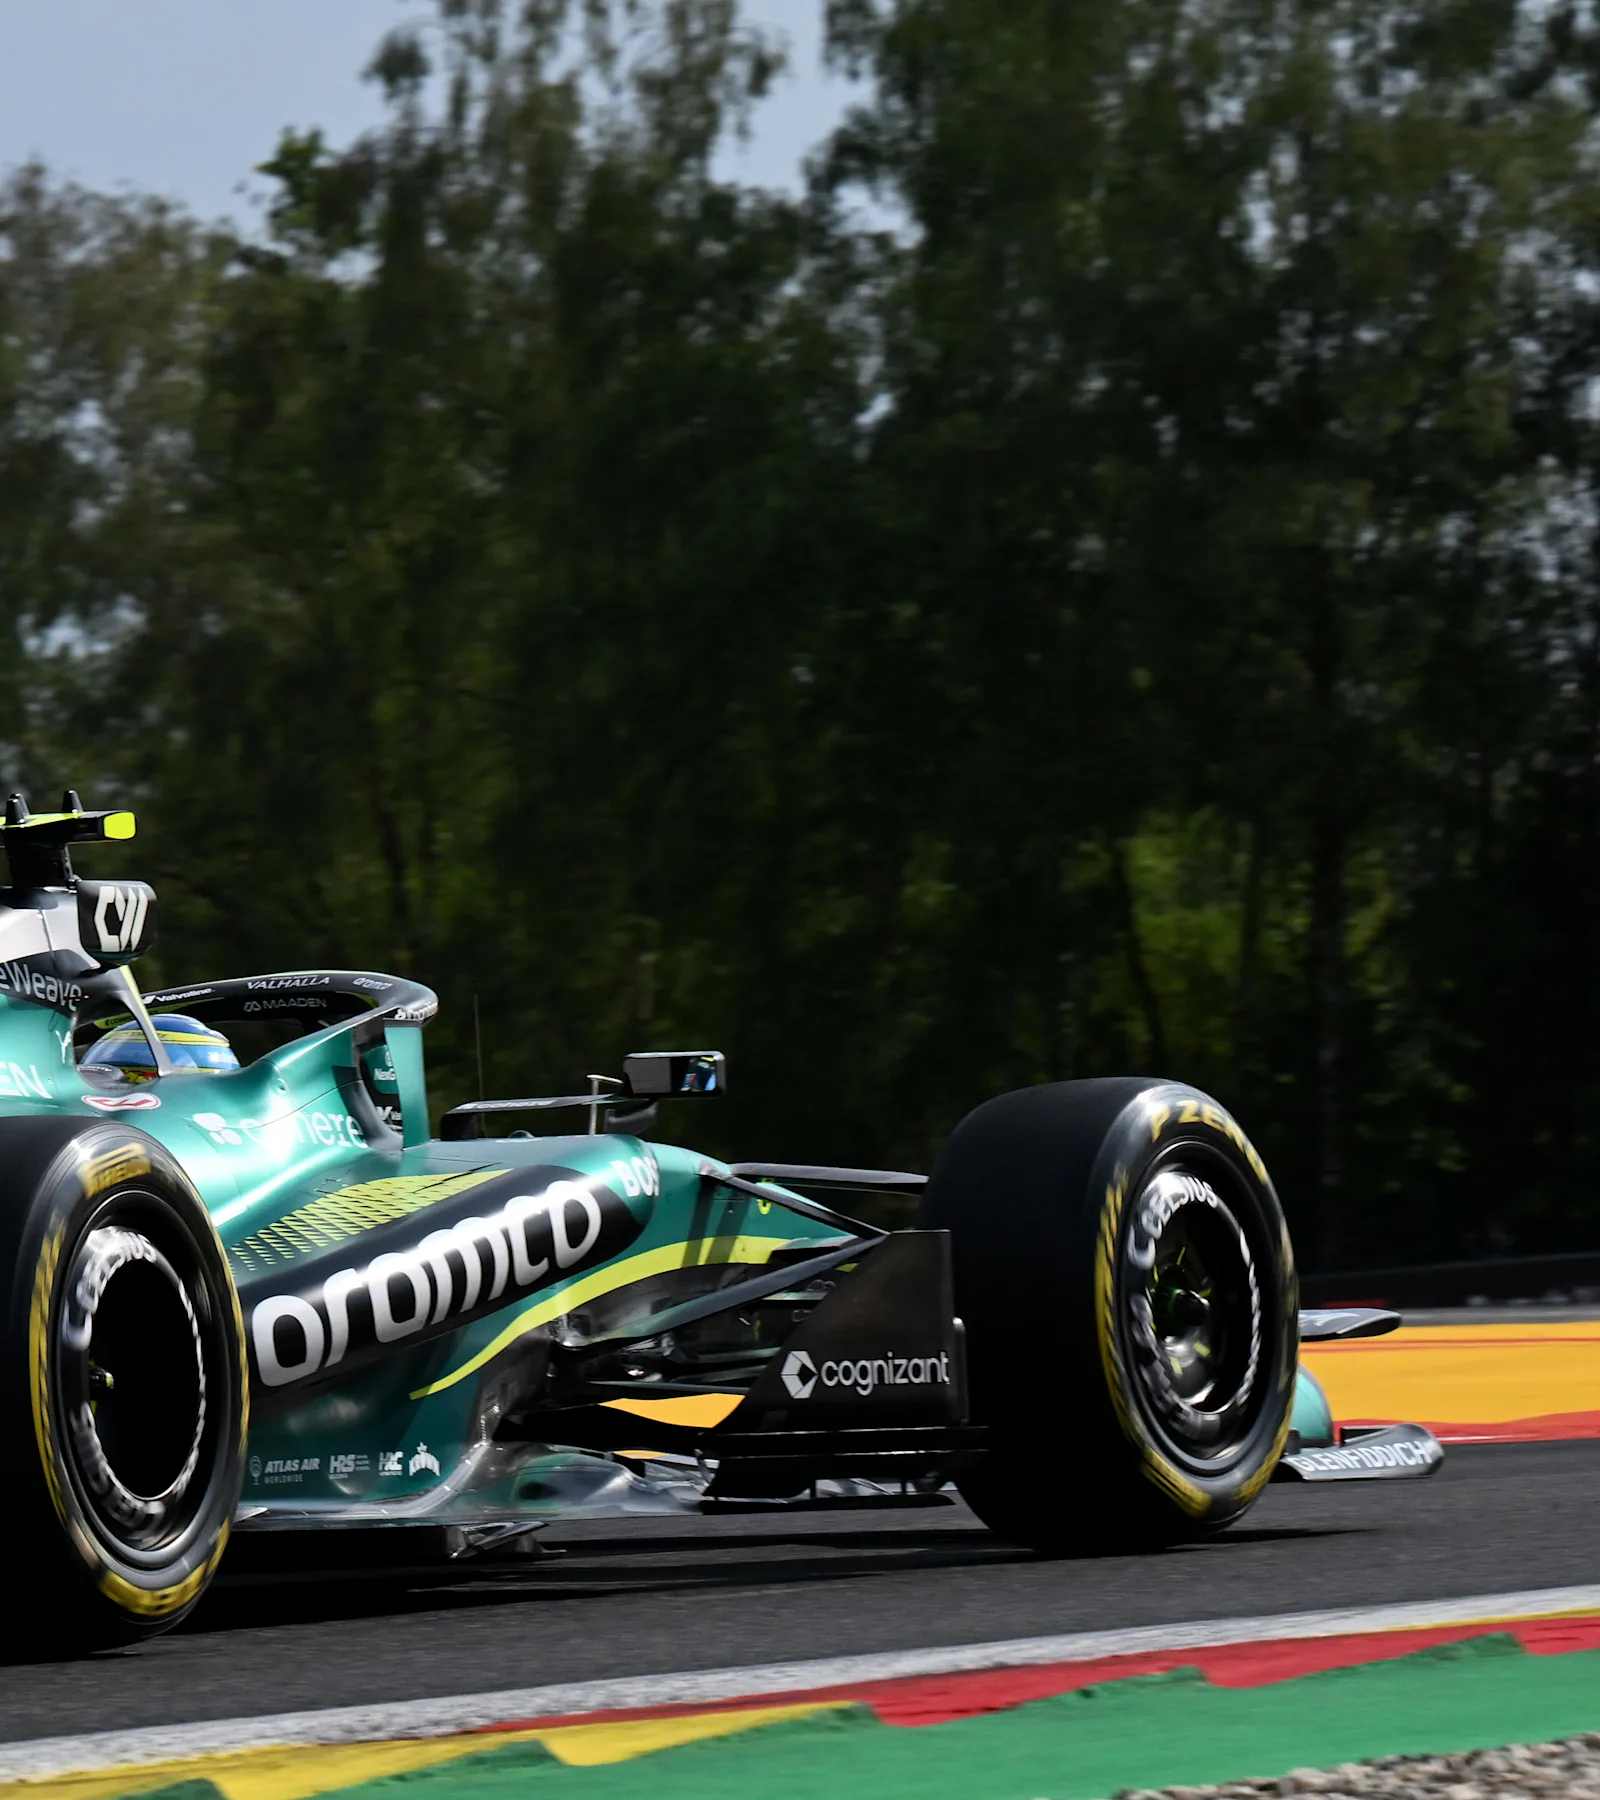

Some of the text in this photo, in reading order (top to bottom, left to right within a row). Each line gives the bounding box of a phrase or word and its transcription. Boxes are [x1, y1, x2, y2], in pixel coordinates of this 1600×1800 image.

[247, 977, 330, 990] VALHALLA
[353, 978, 393, 990] aramco
[156, 989, 213, 1002] Valvoline
[263, 998, 327, 1009] MAADEN
[251, 1180, 603, 1387] aramco
[821, 1351, 950, 1396] cognizant
[1289, 1441, 1433, 1472] GLENFIDDICH
[264, 1458, 321, 1473] ATLAS AIR
